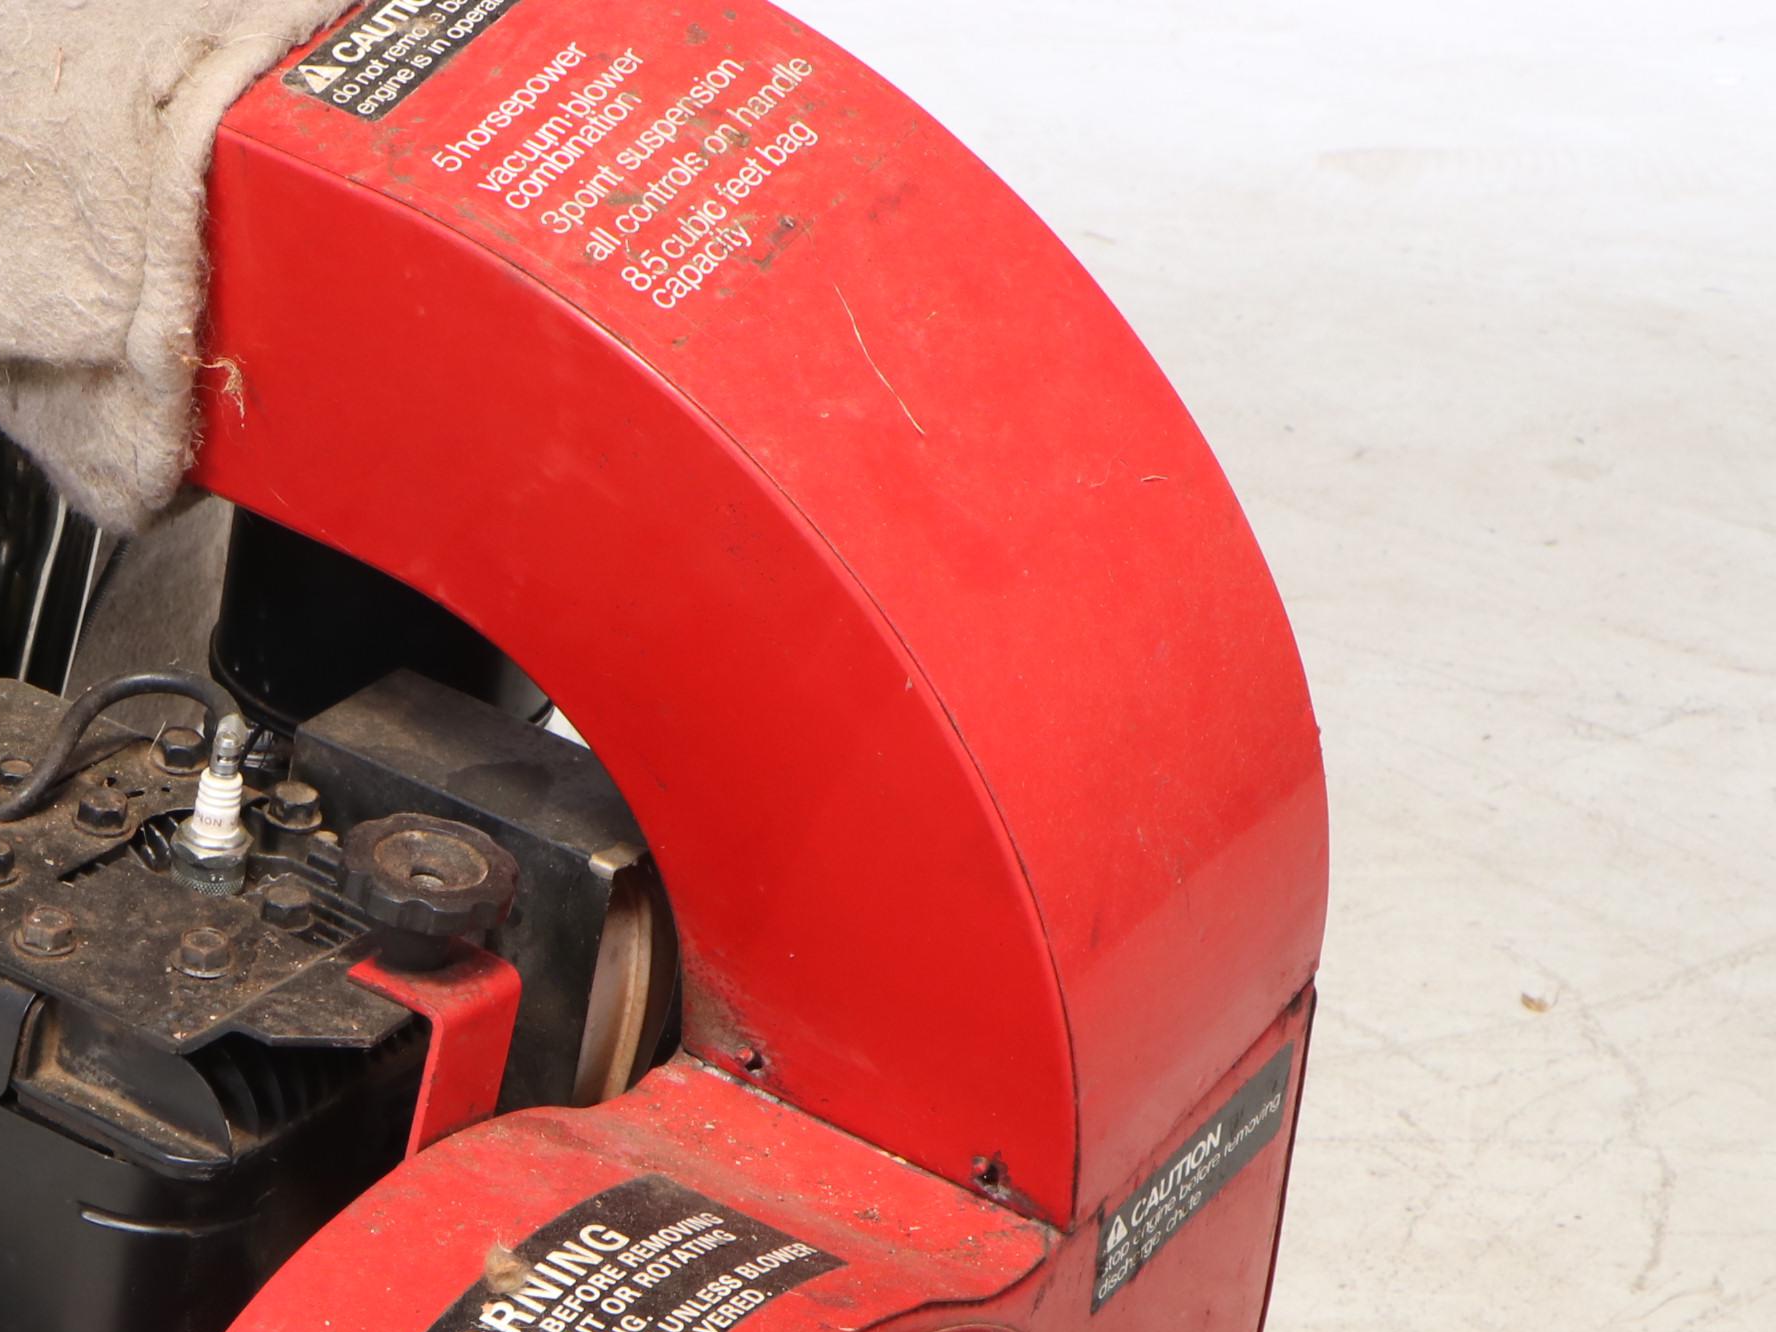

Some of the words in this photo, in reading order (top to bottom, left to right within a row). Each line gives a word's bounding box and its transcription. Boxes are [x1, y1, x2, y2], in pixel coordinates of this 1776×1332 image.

[332, 82, 360, 104] do
[358, 59, 389, 85] not
[382, 12, 446, 62] remoe
[357, 68, 415, 115] engine
[405, 54, 433, 69] is
[422, 38, 451, 55] in
[447, 0, 504, 39] opera
[506, 92, 642, 209] combination
[586, 226, 621, 262] all
[616, 152, 709, 234] controls
[704, 123, 738, 154] on
[727, 57, 813, 128] handle
[616, 58, 745, 170] suspension
[661, 199, 727, 259] cubic
[714, 157, 772, 205] feet
[755, 120, 818, 166] bag
[652, 219, 752, 309] capacity
[1131, 1123, 1222, 1227] CAUTION
[601, 1286, 642, 1315] OR
[632, 1229, 737, 1288] ROTATING
[616, 1212, 724, 1268] REMOVING
[734, 1242, 817, 1280] BLOWER
